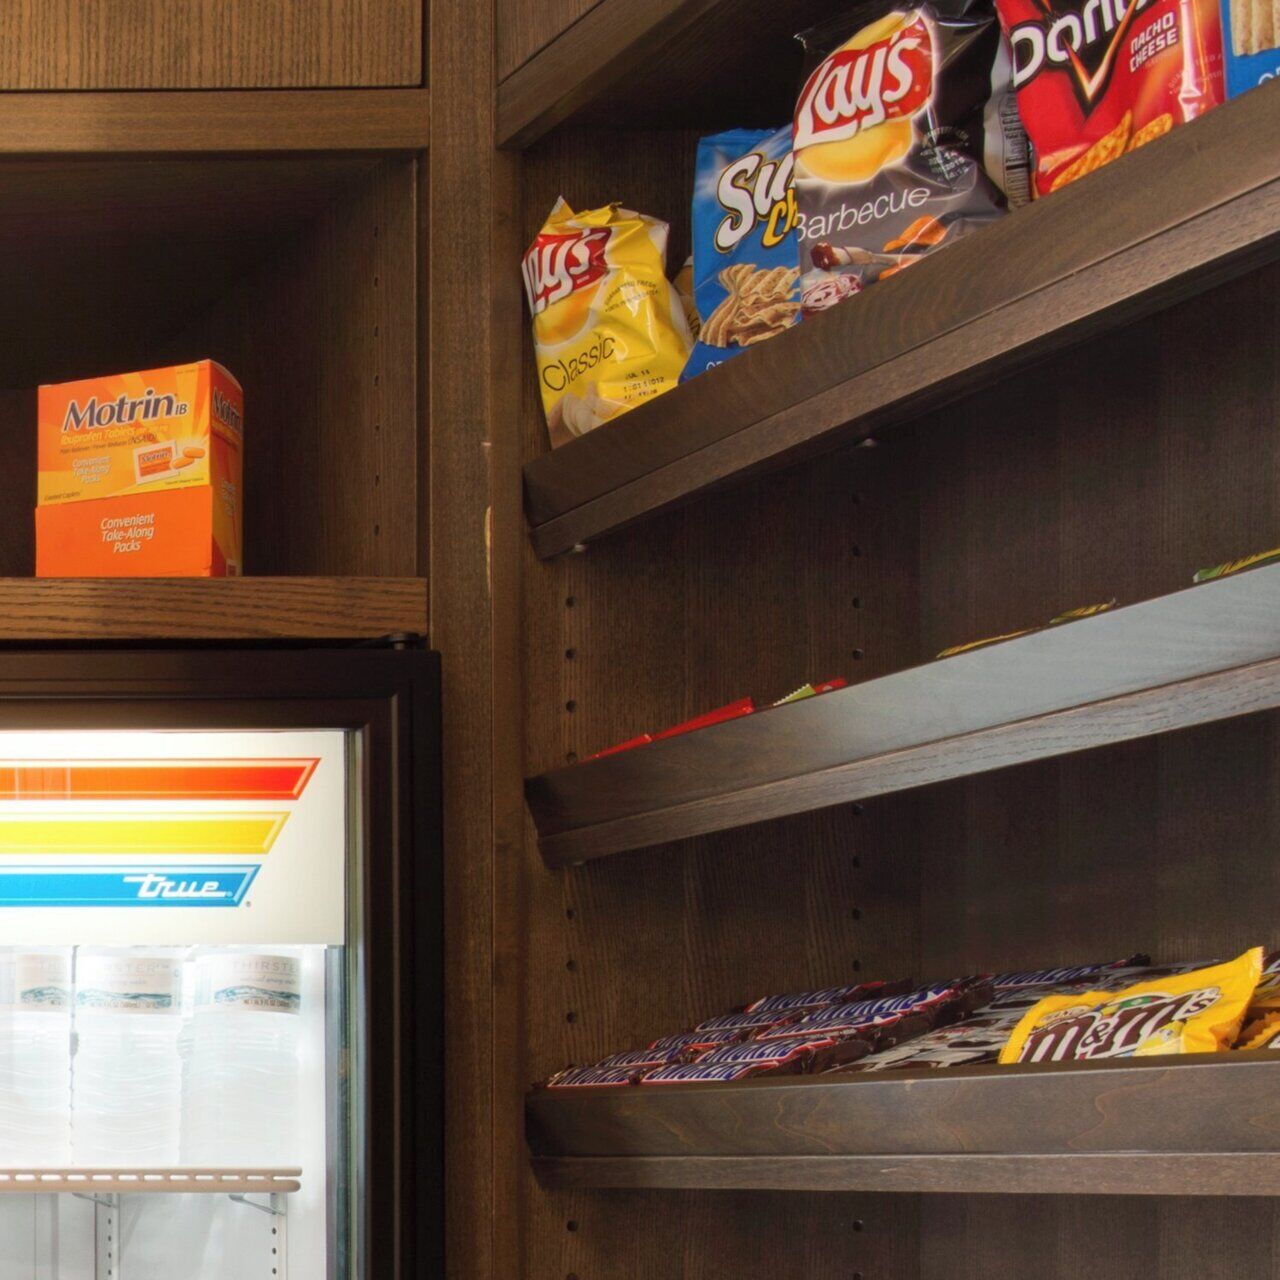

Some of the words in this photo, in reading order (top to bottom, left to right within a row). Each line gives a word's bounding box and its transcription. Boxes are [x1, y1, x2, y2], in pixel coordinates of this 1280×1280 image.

[1129, 28, 1178, 73] CHEESE
[1130, 12, 1175, 54] NACHO
[793, 33, 922, 151] Lay's
[542, 336, 617, 391] Classic
[63, 388, 175, 432] Motrin
[100, 512, 155, 530] Convenient
[101, 526, 155, 543] Take-Along
[113, 540, 141, 554] Packs
